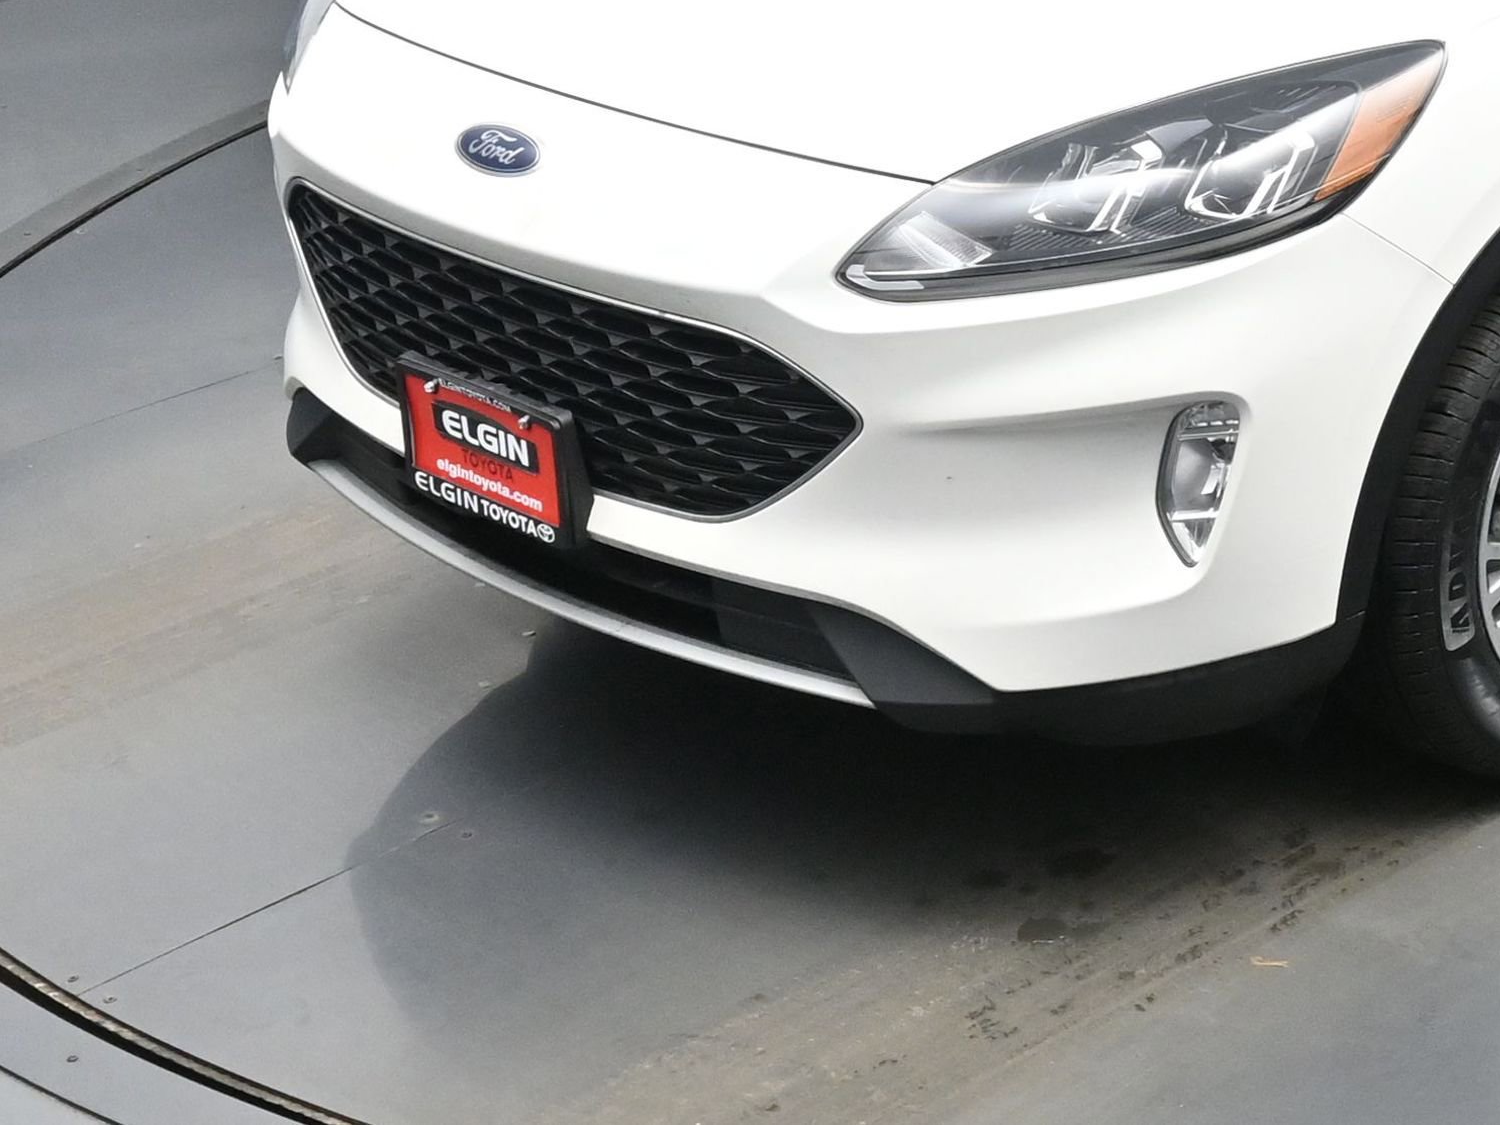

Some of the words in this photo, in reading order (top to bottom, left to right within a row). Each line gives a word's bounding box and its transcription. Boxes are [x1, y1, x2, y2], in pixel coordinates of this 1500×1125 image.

[468, 129, 525, 165] Ford
[441, 409, 530, 467] ELGIN
[461, 448, 514, 482] TOYOTA
[415, 471, 479, 513] ELGIN
[480, 499, 538, 538] TOYOTA
[436, 458, 543, 512] elgintoyota.com
